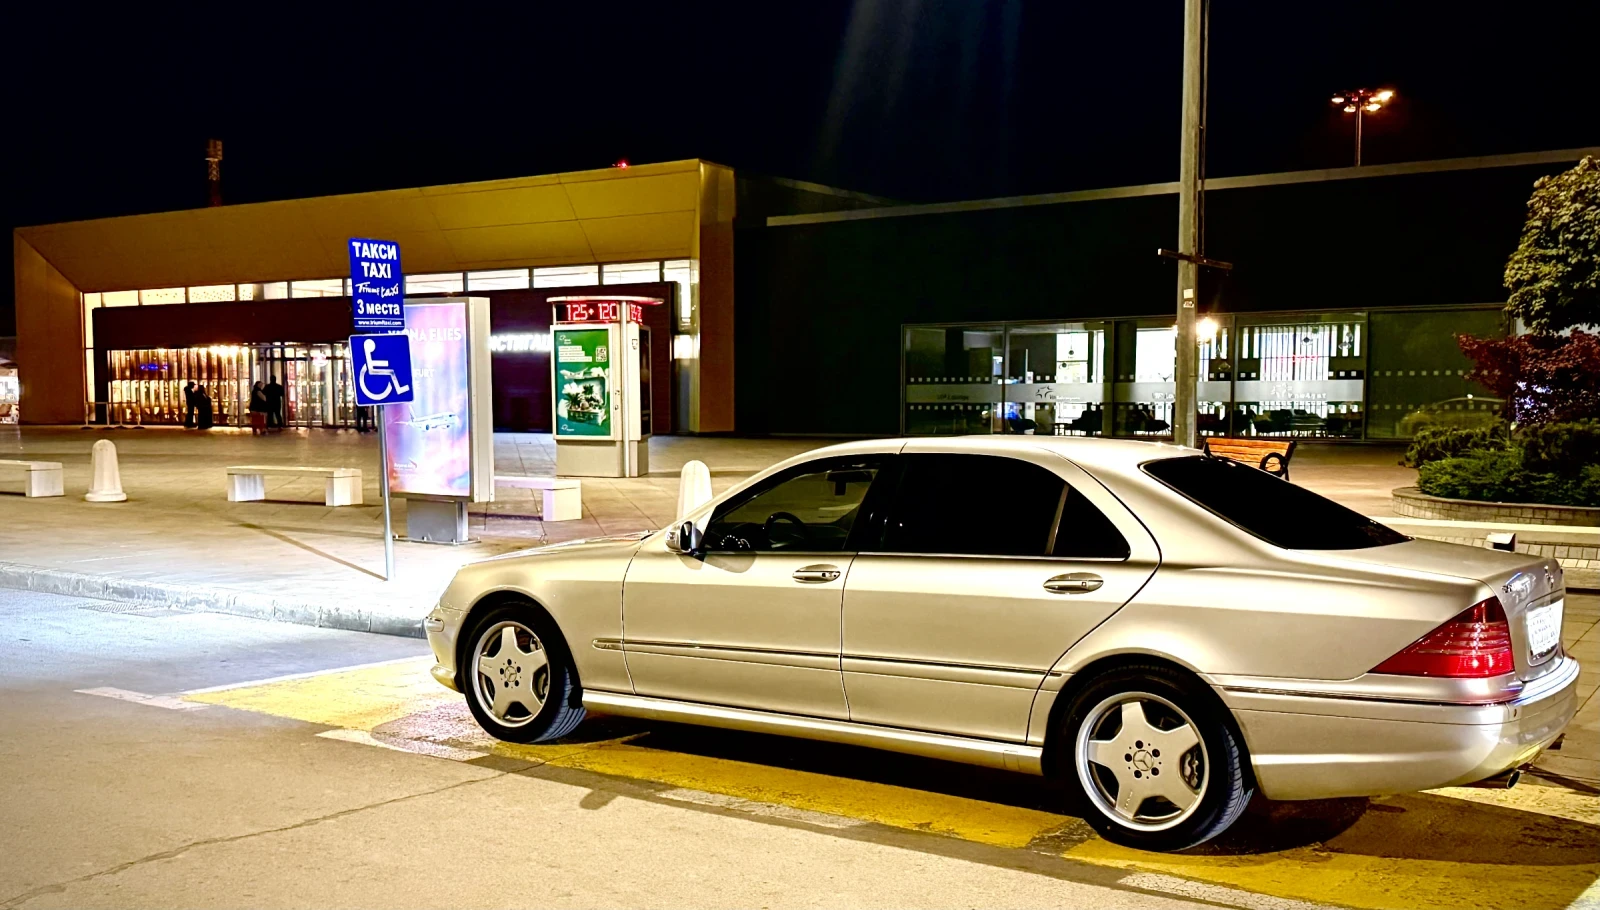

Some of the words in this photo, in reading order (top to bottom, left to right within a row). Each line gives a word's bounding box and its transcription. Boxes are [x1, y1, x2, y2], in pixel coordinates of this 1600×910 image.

[352, 241, 397, 260] ТАКСИ
[361, 261, 391, 279] TAXI
[357, 299, 364, 314] 3
[366, 302, 400, 315] места
